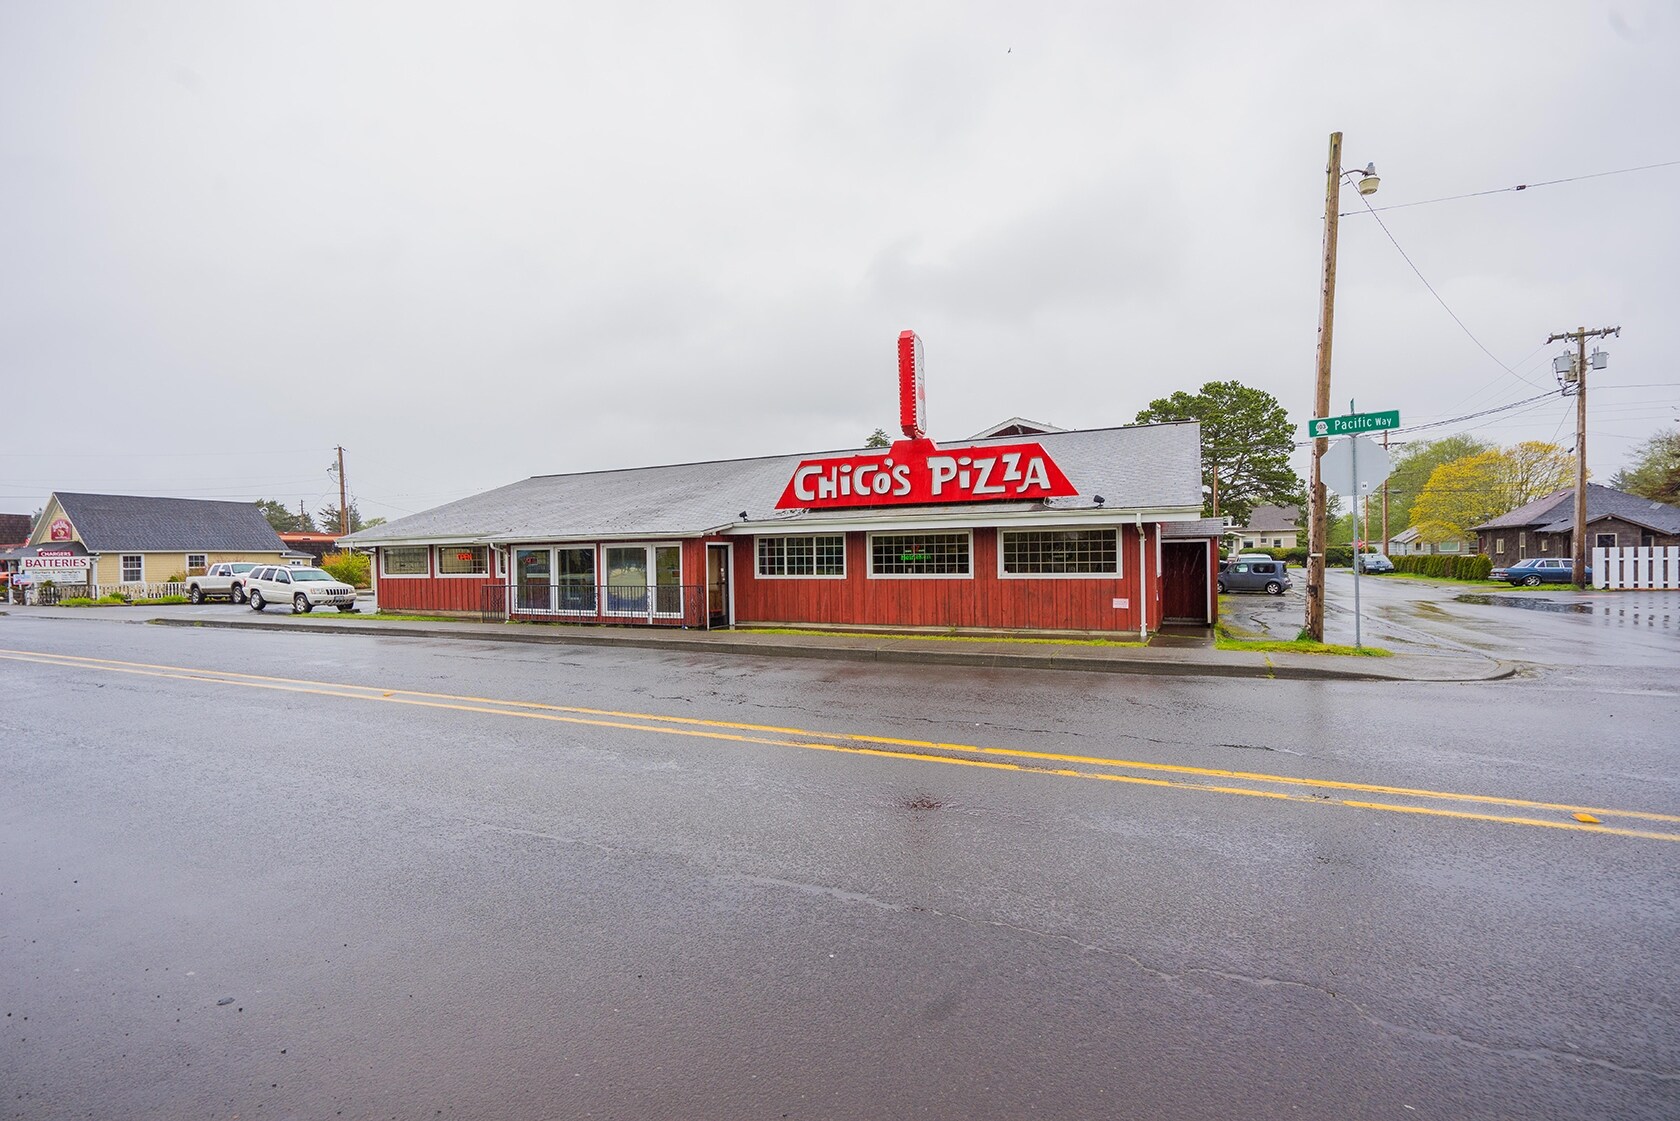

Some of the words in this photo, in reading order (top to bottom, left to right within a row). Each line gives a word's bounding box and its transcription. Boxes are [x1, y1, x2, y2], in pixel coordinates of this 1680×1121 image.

[1334, 417, 1372, 430] Pacific
[1375, 417, 1392, 427] Way
[456, 552, 472, 560] OPEN
[25, 559, 86, 567] BATTERIES
